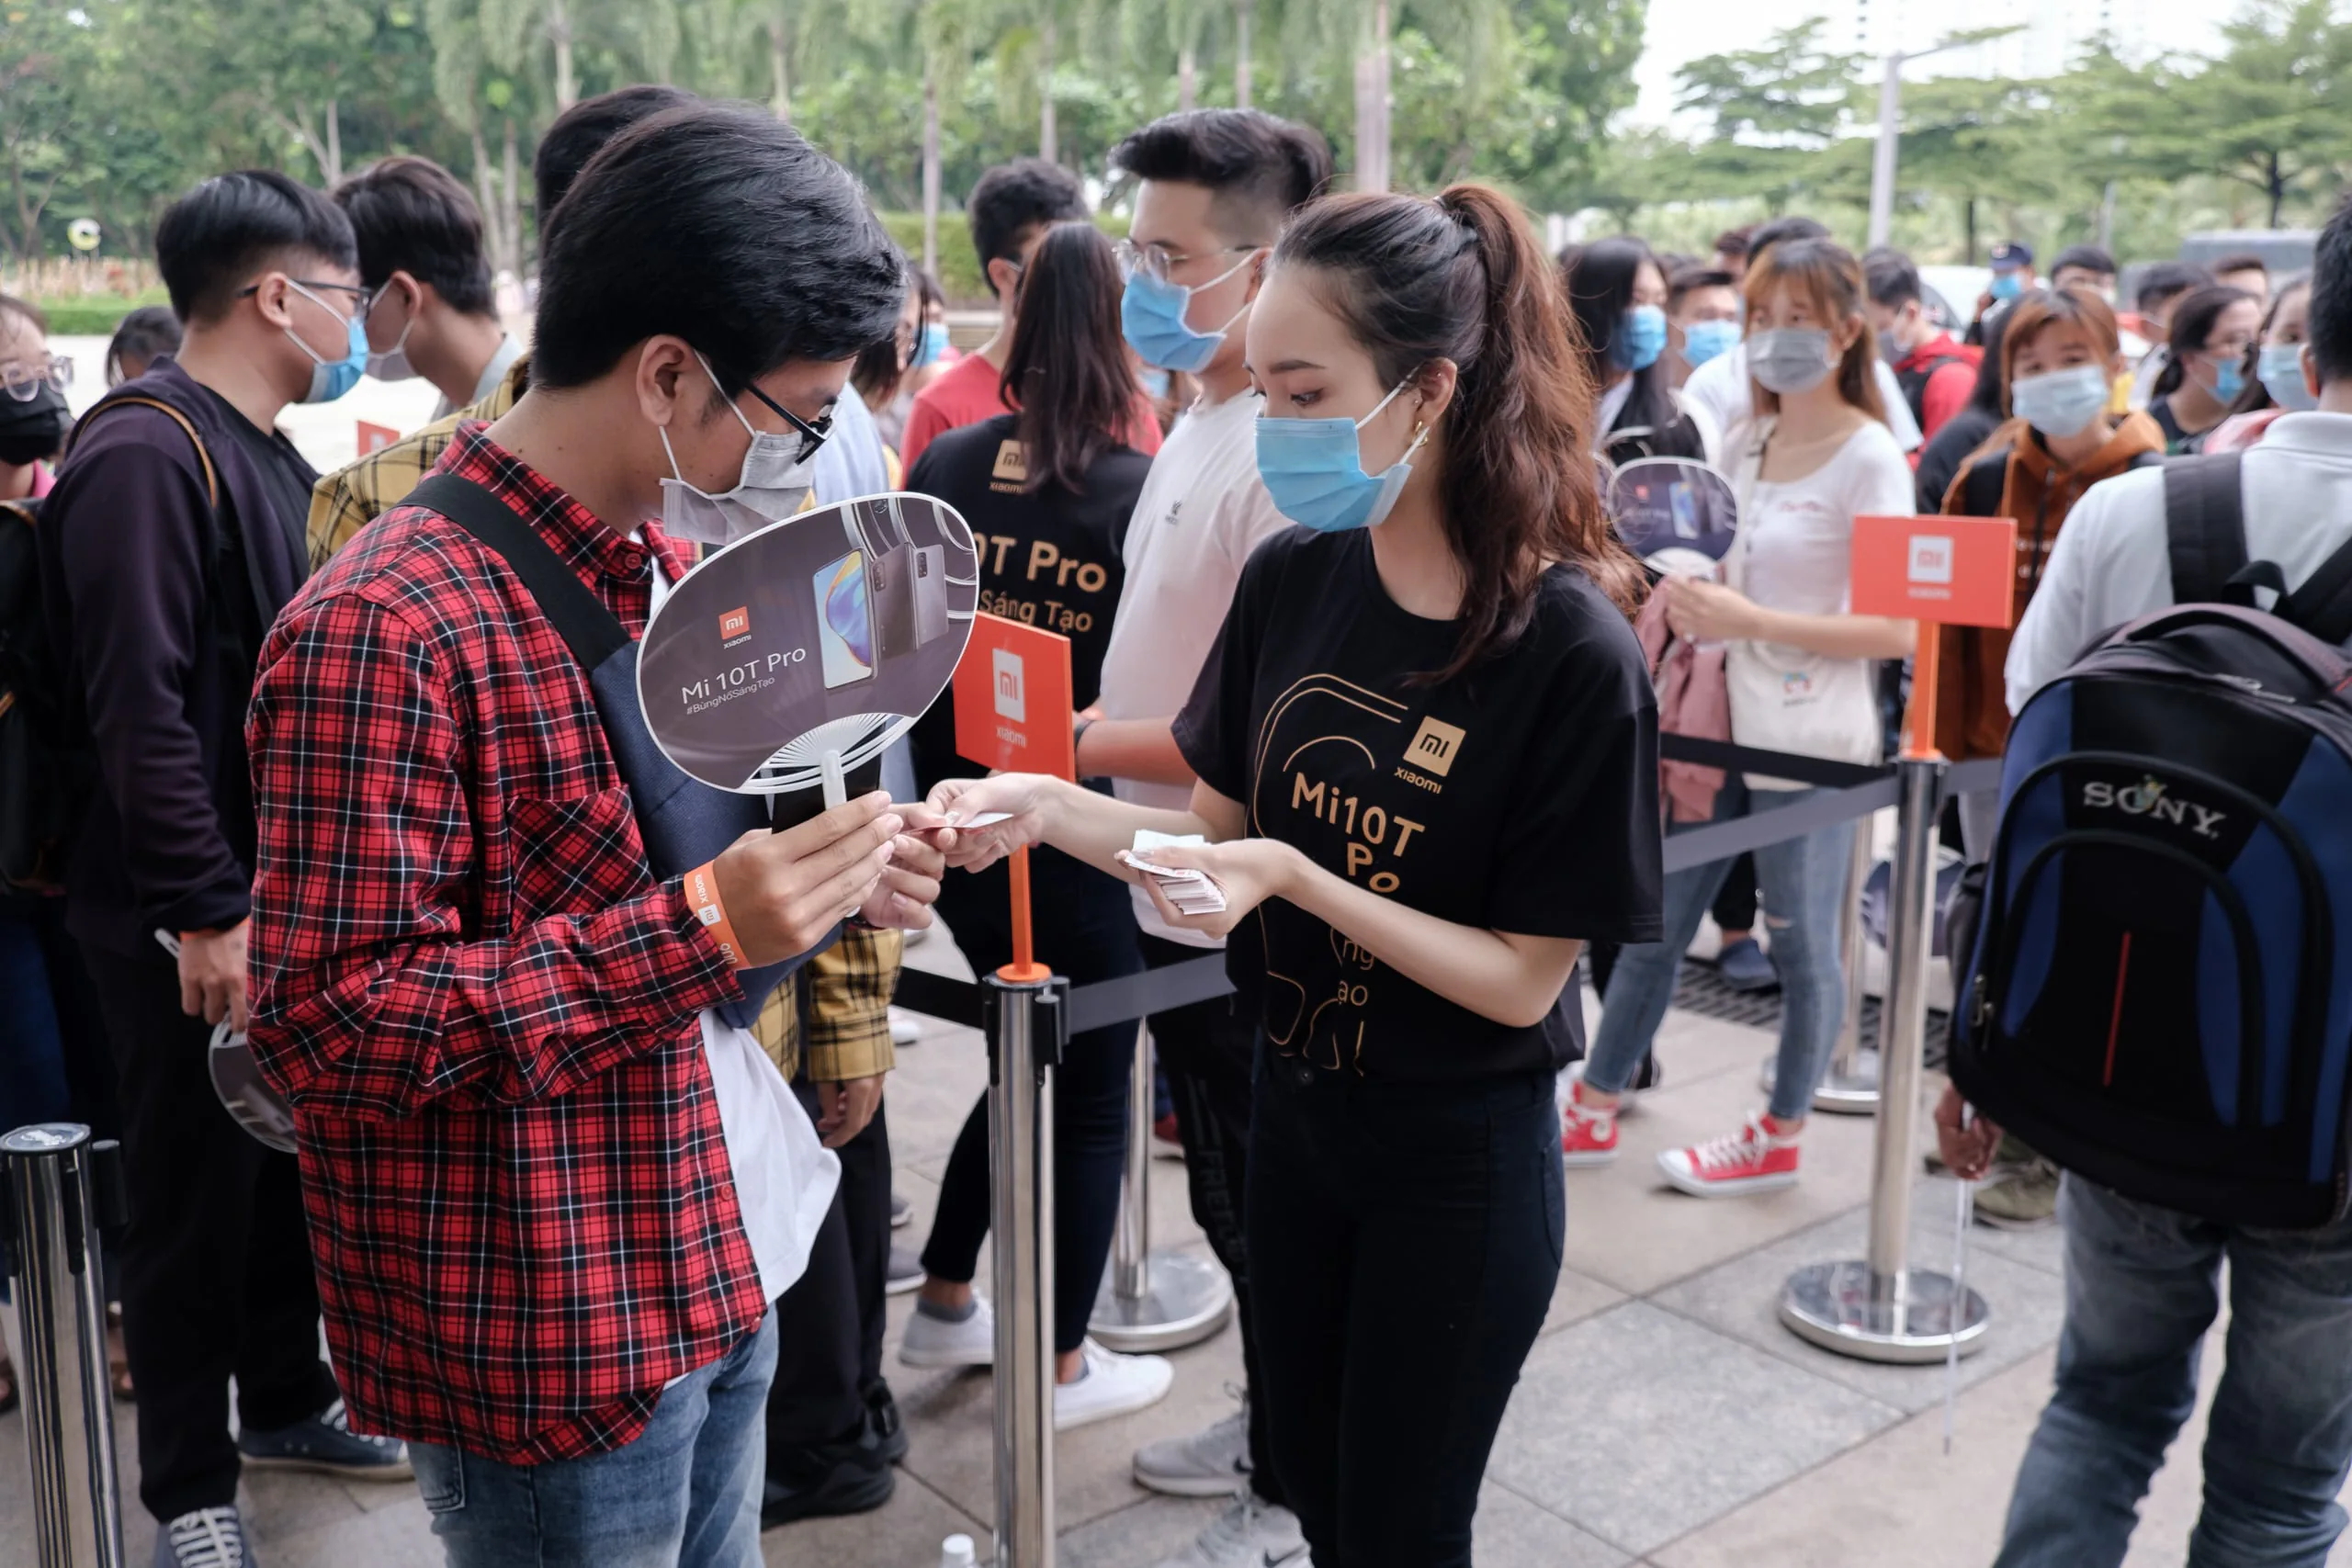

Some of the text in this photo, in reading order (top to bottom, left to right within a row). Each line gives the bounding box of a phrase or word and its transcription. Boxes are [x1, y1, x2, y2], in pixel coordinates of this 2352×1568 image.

[1026, 539, 1108, 593] Pro
[1043, 599, 1094, 634] Tạo
[723, 635, 752, 649] xiaomi
[681, 648, 807, 705] Mi 10T Pro
[995, 725, 1026, 749] xiaomi
[1394, 765, 1443, 795] xiaomi
[2083, 781, 2227, 836] SONY
